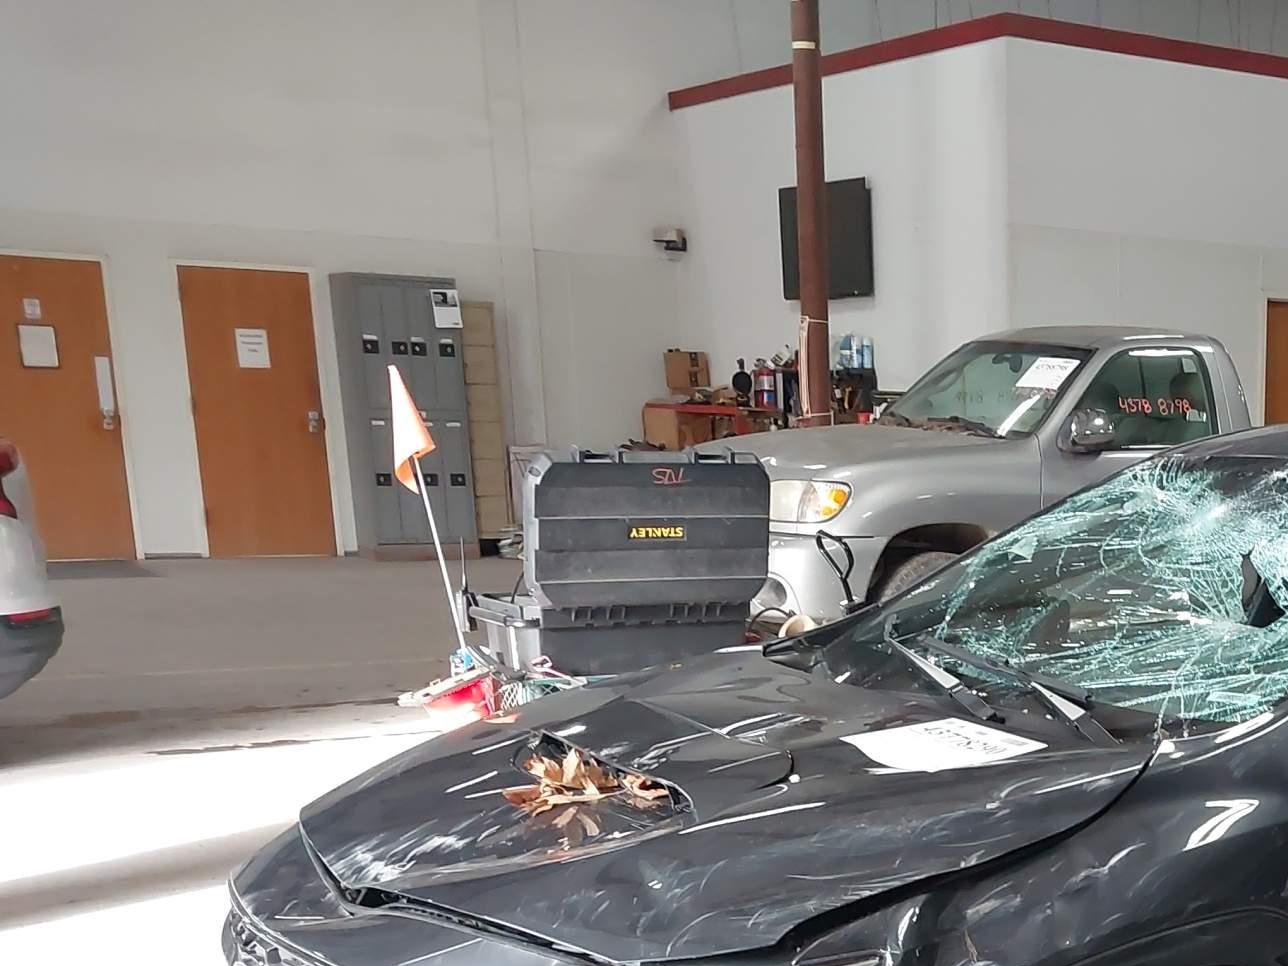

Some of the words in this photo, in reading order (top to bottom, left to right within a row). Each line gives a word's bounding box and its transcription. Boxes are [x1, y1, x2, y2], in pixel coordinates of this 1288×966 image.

[1118, 396, 1152, 414] 4578
[1157, 398, 1192, 415] 8798
[630, 527, 684, 538] STANLEY
